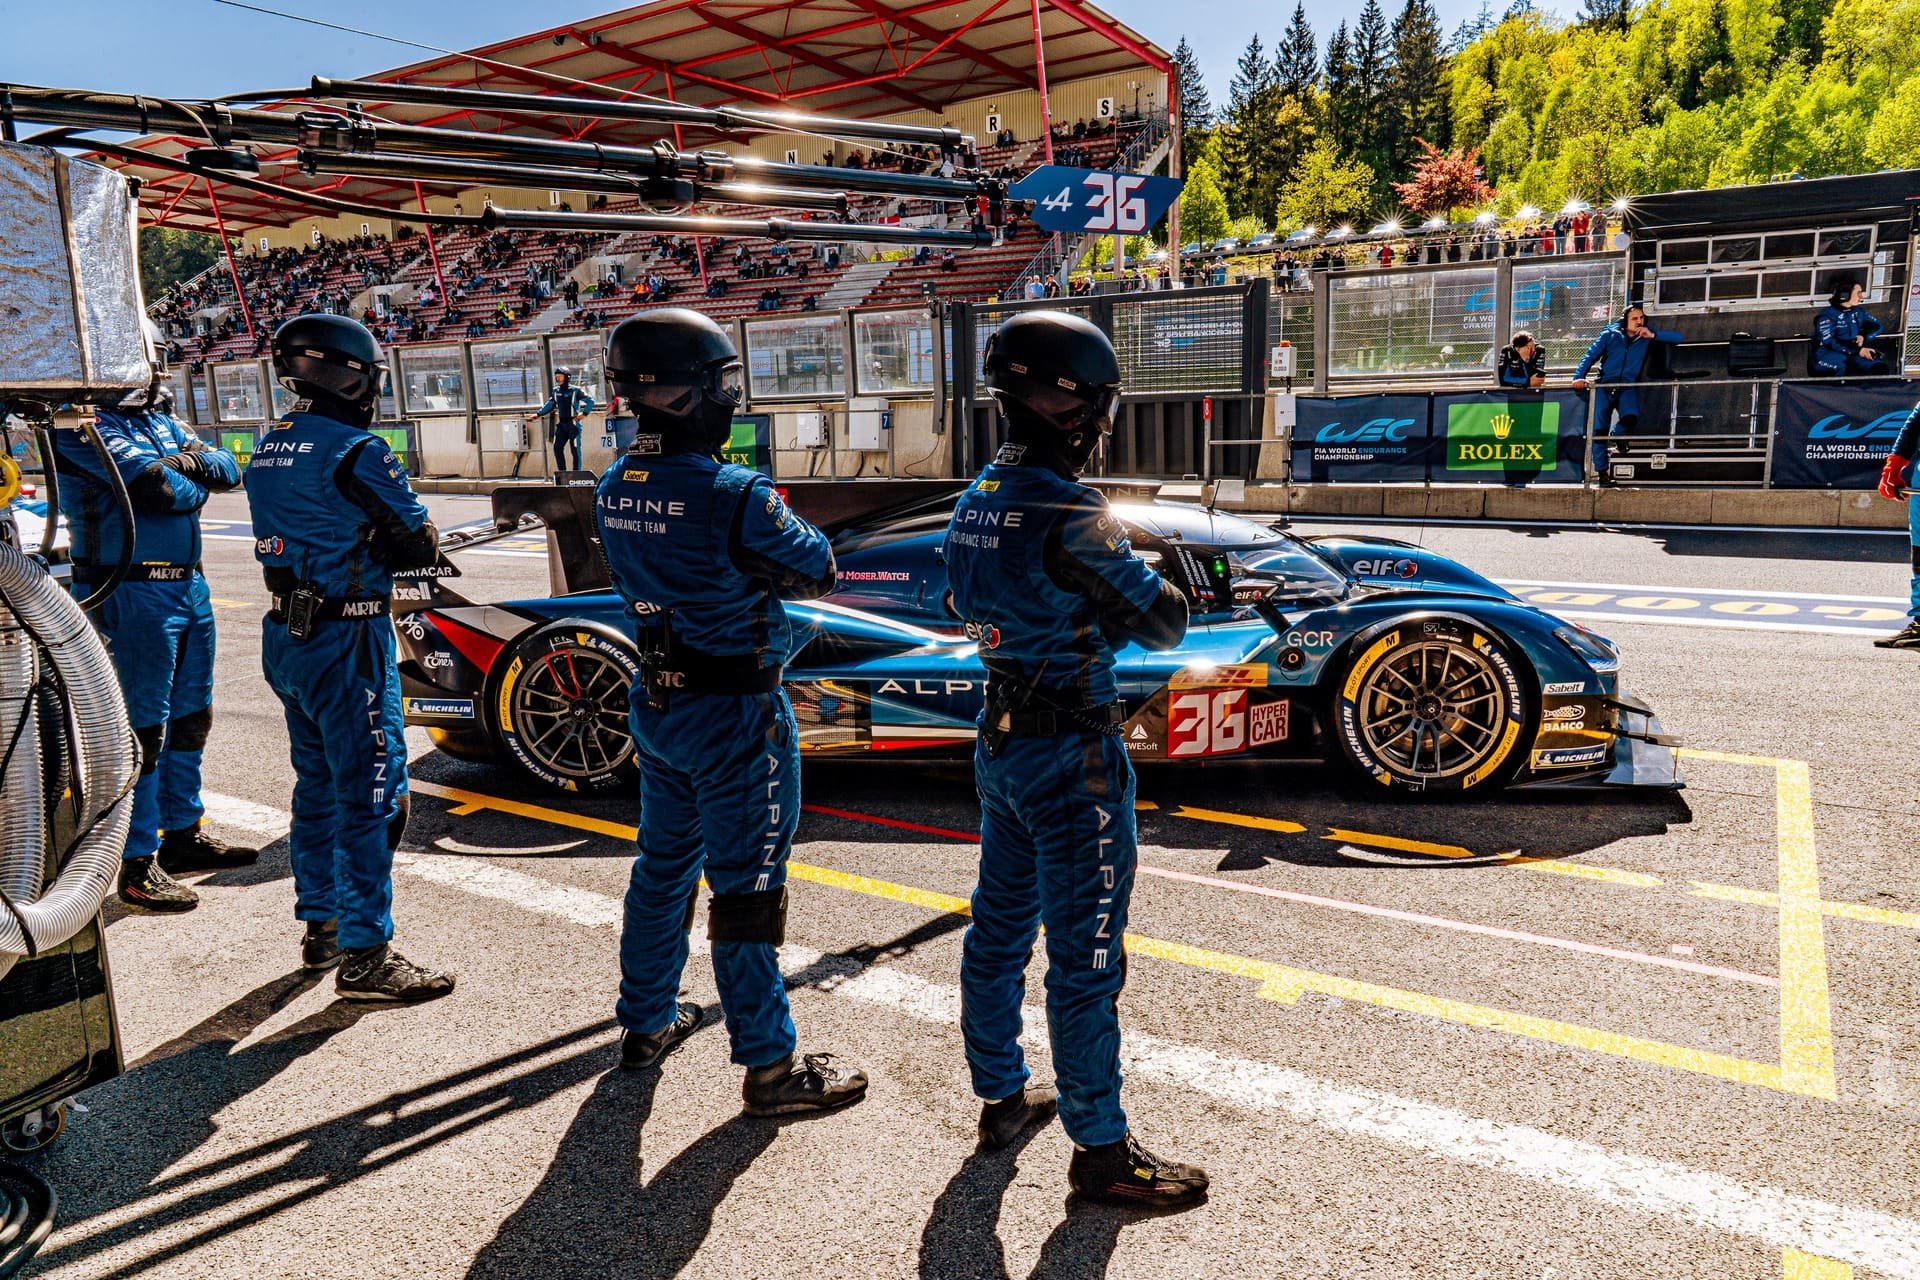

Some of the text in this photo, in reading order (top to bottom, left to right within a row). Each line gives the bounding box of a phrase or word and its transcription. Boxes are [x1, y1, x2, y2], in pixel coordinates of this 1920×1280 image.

[1101, 100, 1109, 115] S
[990, 117, 997, 131] R
[787, 152, 796, 164] N
[1082, 173, 1147, 232] 36
[362, 224, 368, 235] D
[541, 282, 550, 295] K
[1315, 418, 1415, 442] WEC
[1808, 410, 1911, 438] WE
[601, 436, 612, 447] 78
[1459, 444, 1543, 460] ROLEX
[1806, 452, 1889, 460] CHAMPIONSHIP
[276, 457, 294, 467] TEAM
[597, 495, 685, 516] ALPINE
[604, 516, 666, 534] ENDURANCE TEAM
[949, 531, 1000, 549] ENDURANCE TEAM
[149, 567, 185, 580] MRTC
[1353, 560, 1393, 576] elf
[1234, 592, 1251, 600] elf
[342, 600, 382, 617] MRTC
[1287, 631, 1334, 647] GCR
[1384, 636, 1396, 647] M
[598, 641, 640, 676] MICHEL
[1356, 655, 1371, 675] SPORT
[657, 670, 685, 688] RTC
[877, 678, 989, 696] ALPI
[1491, 652, 1521, 715] MICHELIN
[1548, 683, 1580, 693] Sabelt
[422, 704, 472, 713] MICHELIN
[1252, 703, 1287, 722] HYPER
[1171, 688, 1247, 756] 36
[1252, 717, 1286, 742] CAR
[1544, 721, 1585, 731] BAHCO
[1343, 706, 1373, 767] MICHELIN
[365, 688, 387, 803] ALPINE
[1124, 742, 1158, 751] EWESoft
[508, 737, 556, 783] MICHELIN
[1554, 751, 1604, 762] MICHELIN
[1467, 774, 1477, 785] M
[755, 753, 780, 891] ALPINE
[1093, 805, 1114, 969] ALPINE
